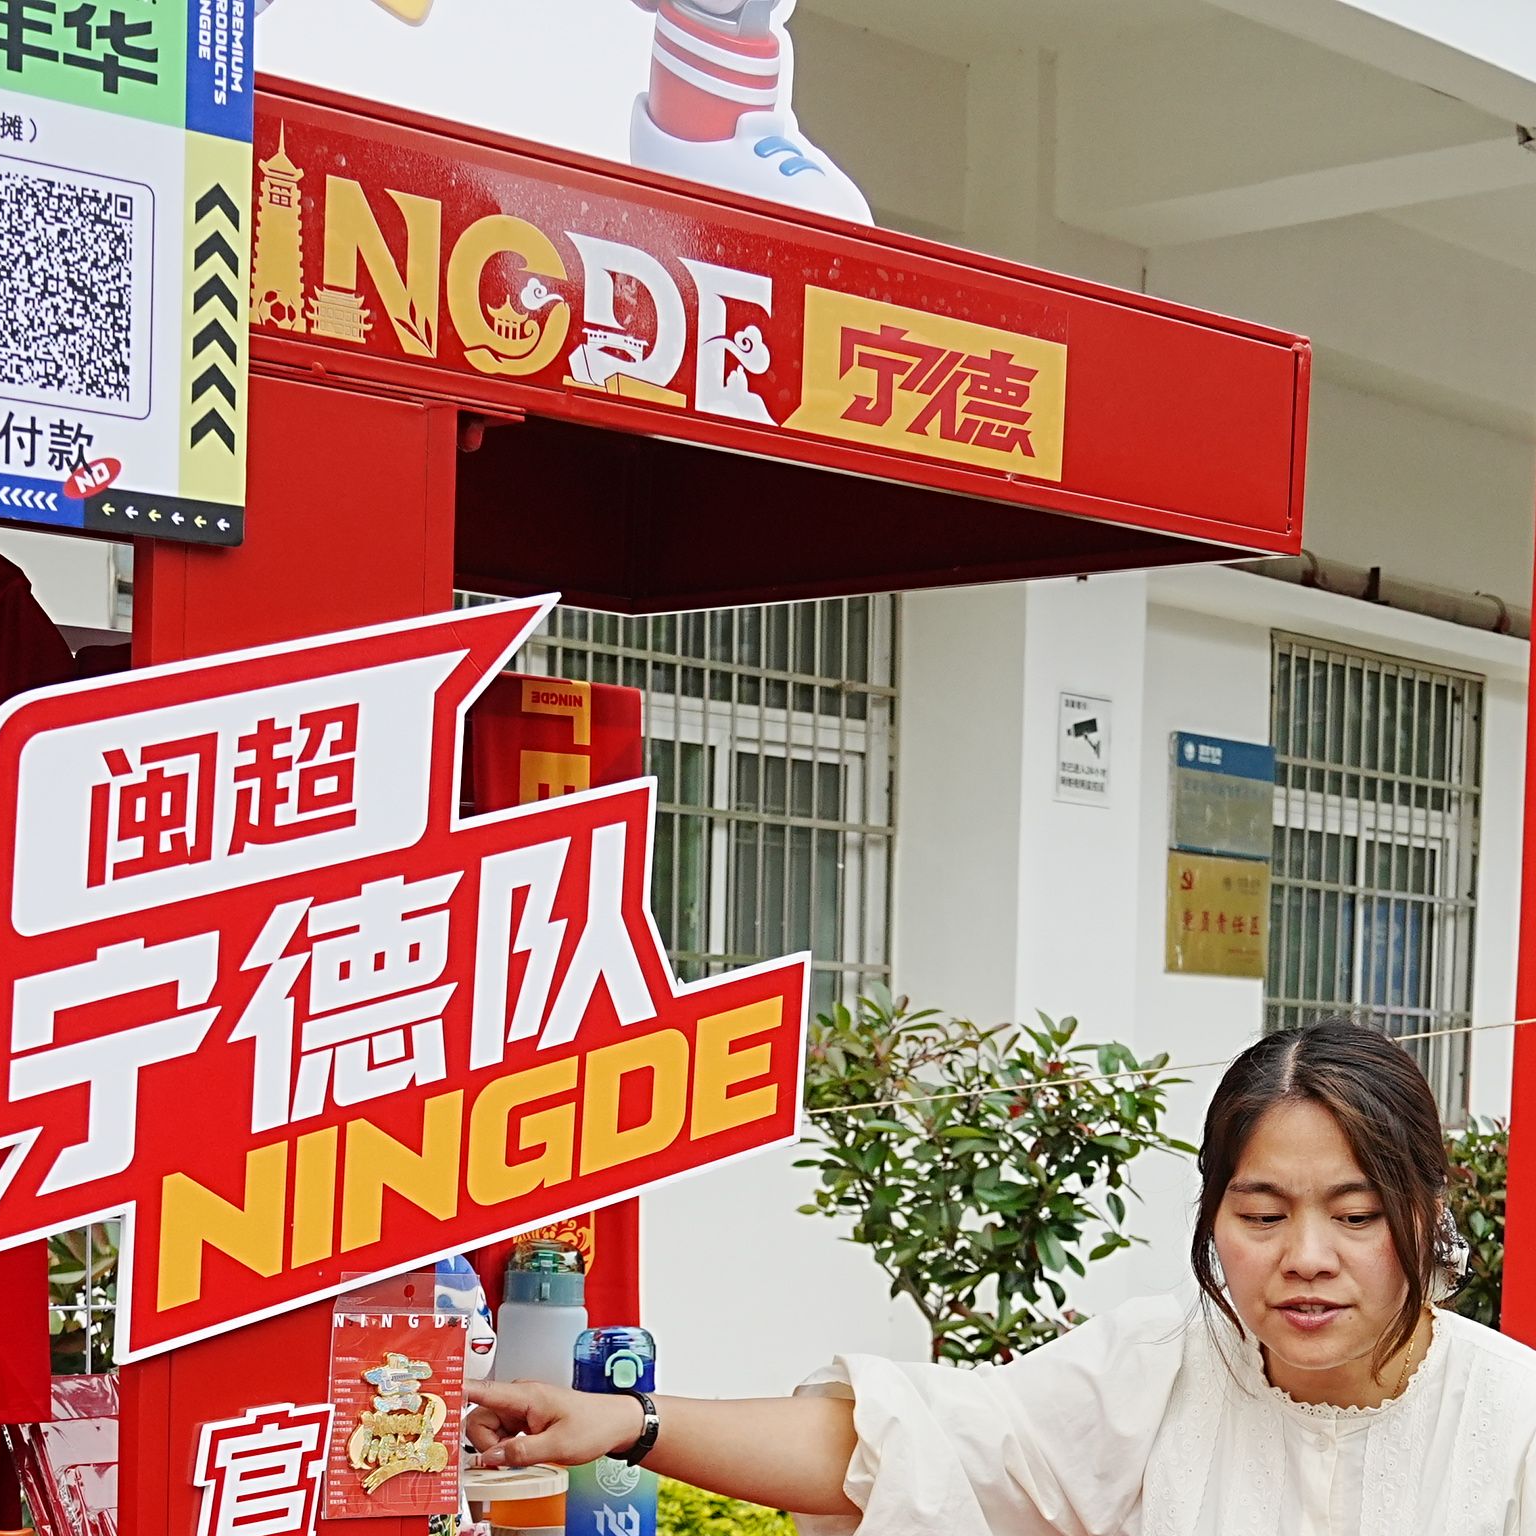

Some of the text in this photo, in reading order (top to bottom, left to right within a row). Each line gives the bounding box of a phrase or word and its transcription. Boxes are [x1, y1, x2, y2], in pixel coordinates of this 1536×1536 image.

[198, 0, 212, 60] NGDE
[231, 0, 245, 93] REMIUM
[840, 325, 1037, 458] 宁德
[74, 462, 111, 494] ND
[530, 690, 583, 708] NINGDE
[87, 703, 361, 889] 闽超
[8, 821, 659, 1197] 宁德队
[156, 995, 785, 1314] NINGDE
[334, 1314, 470, 1329] NINGDE
